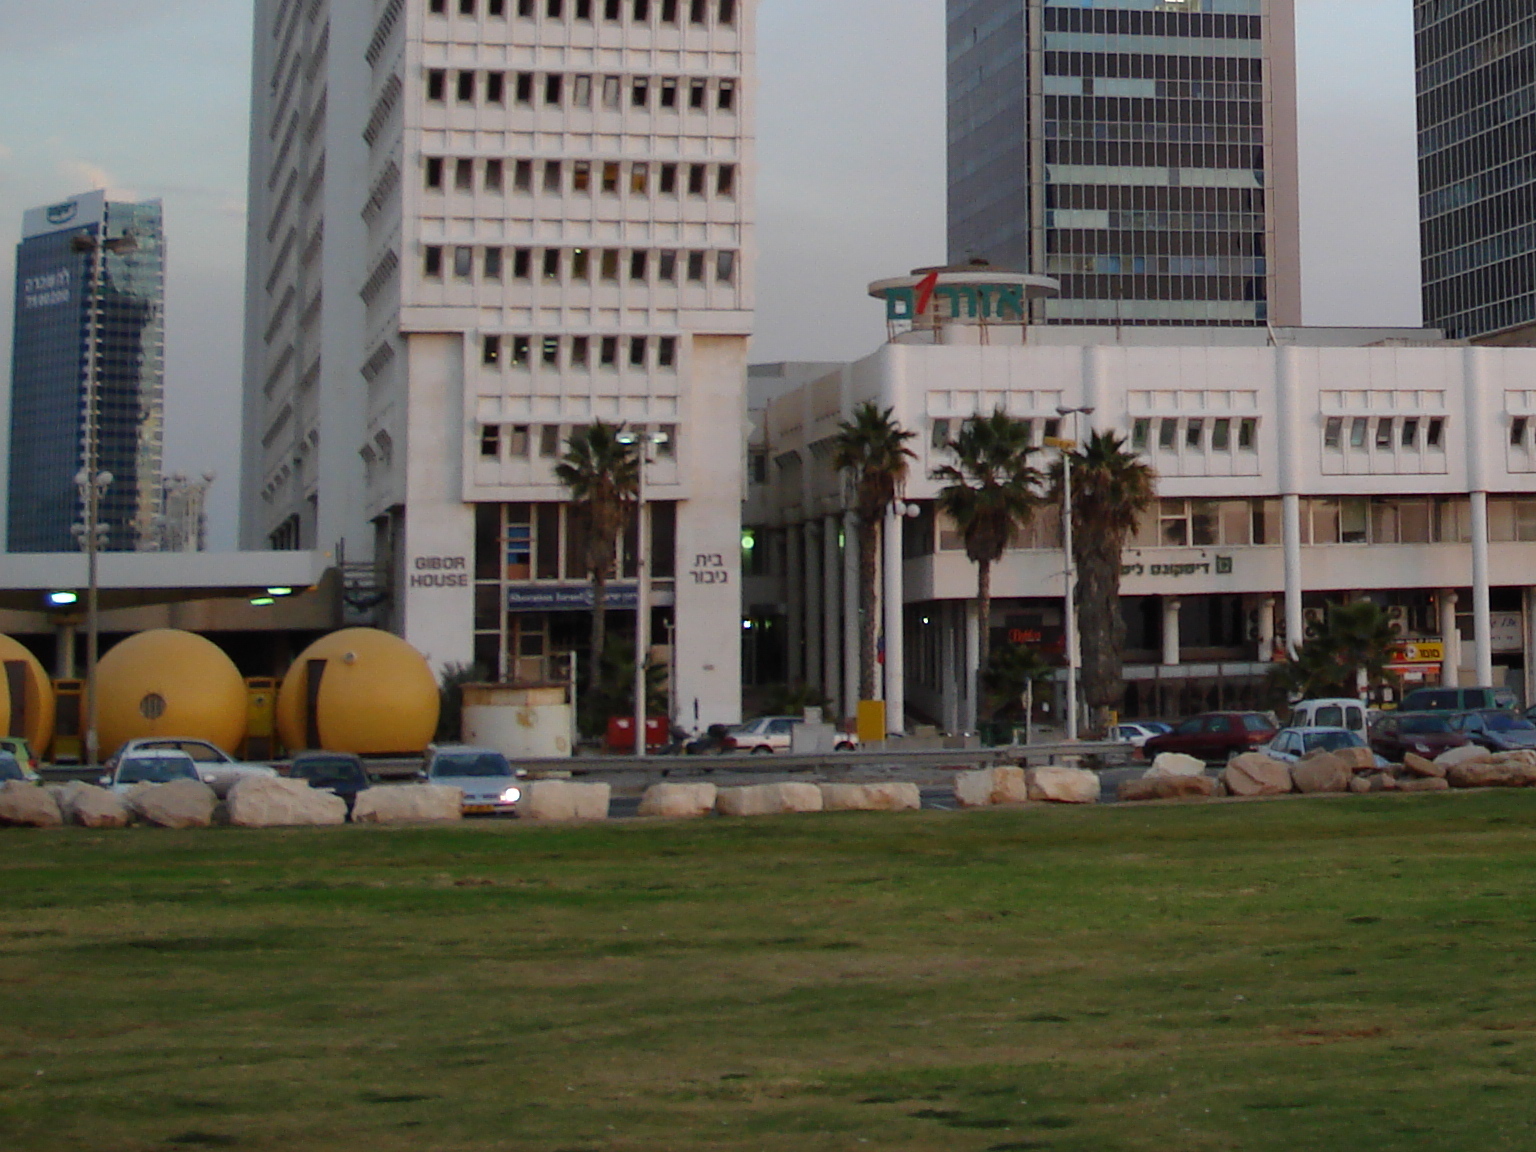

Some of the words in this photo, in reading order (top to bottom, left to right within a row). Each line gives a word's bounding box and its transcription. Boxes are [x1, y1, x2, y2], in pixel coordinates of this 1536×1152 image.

[415, 557, 465, 569] GIBOR
[694, 554, 723, 567] בית
[1150, 562, 1210, 577] דיסקונט
[410, 574, 468, 587] HOUSE
[690, 571, 727, 583] גיבור
